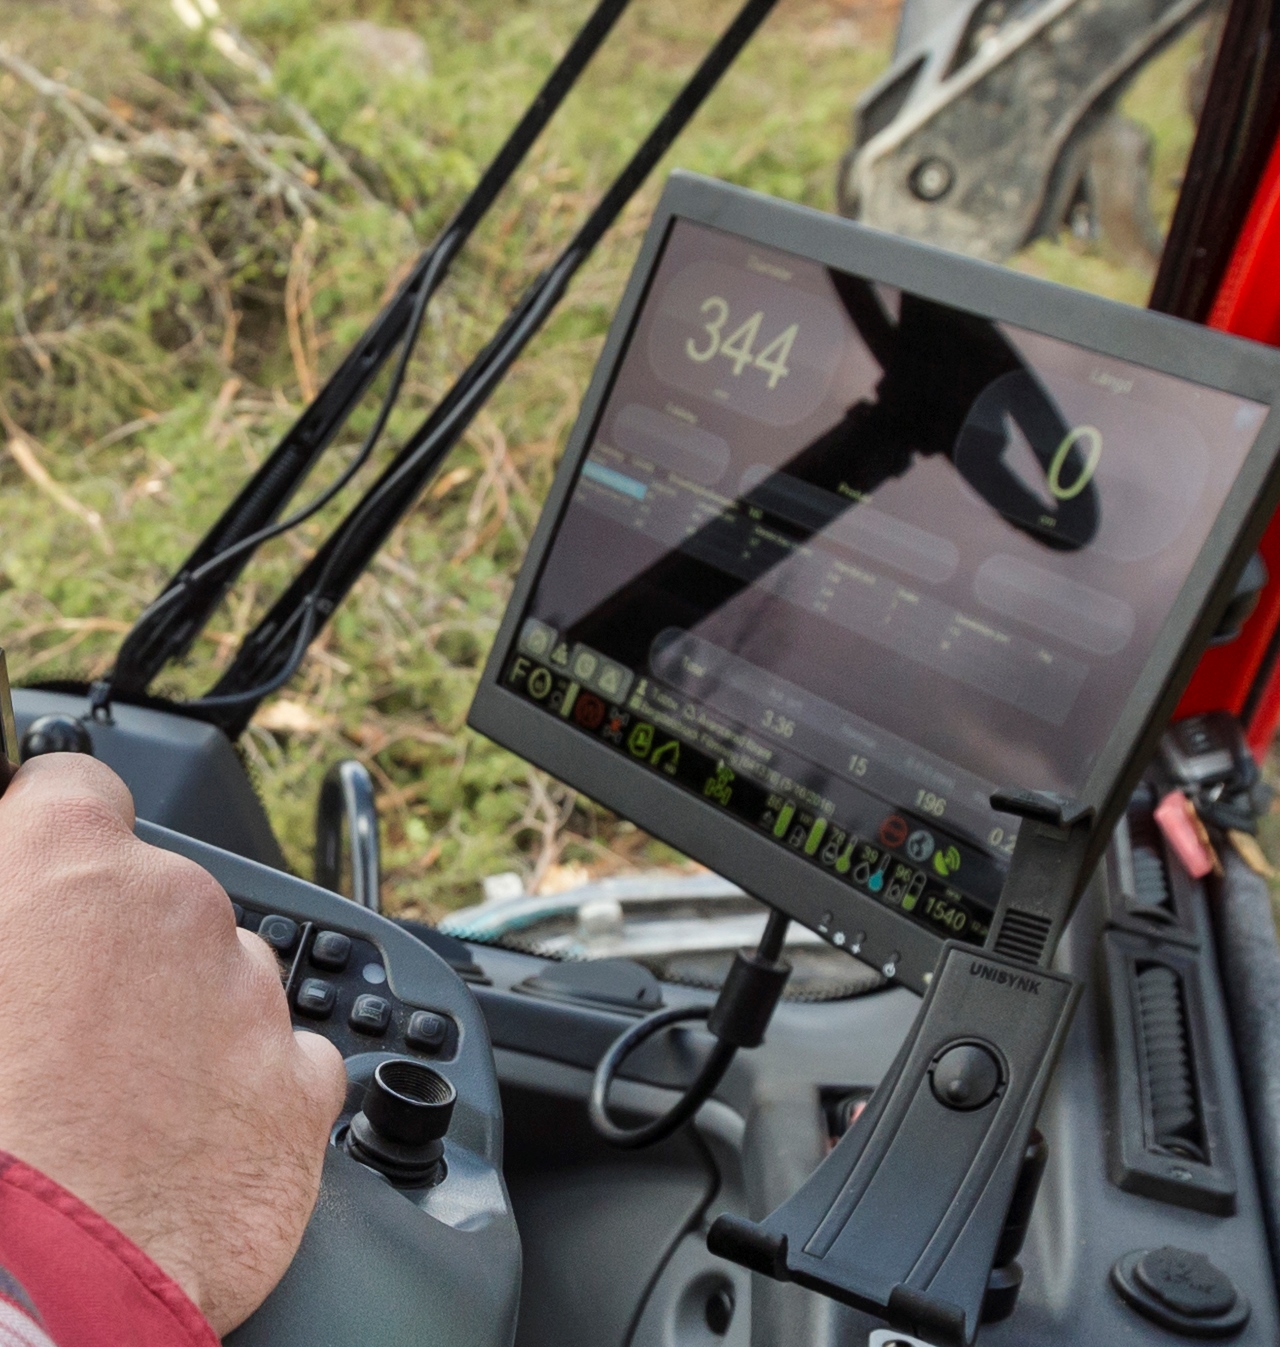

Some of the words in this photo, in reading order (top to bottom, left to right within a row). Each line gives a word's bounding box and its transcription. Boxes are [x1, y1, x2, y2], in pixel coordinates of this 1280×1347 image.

[685, 295, 799, 390] 344
[1047, 424, 1102, 499] 0
[761, 709, 796, 738] 3.36
[849, 754, 868, 777] 15
[916, 789, 947, 817] 196
[860, 845, 879, 865] 39
[894, 864, 913, 883] 96
[924, 896, 967, 932] 1540
[970, 962, 1041, 995] UNISYNK
